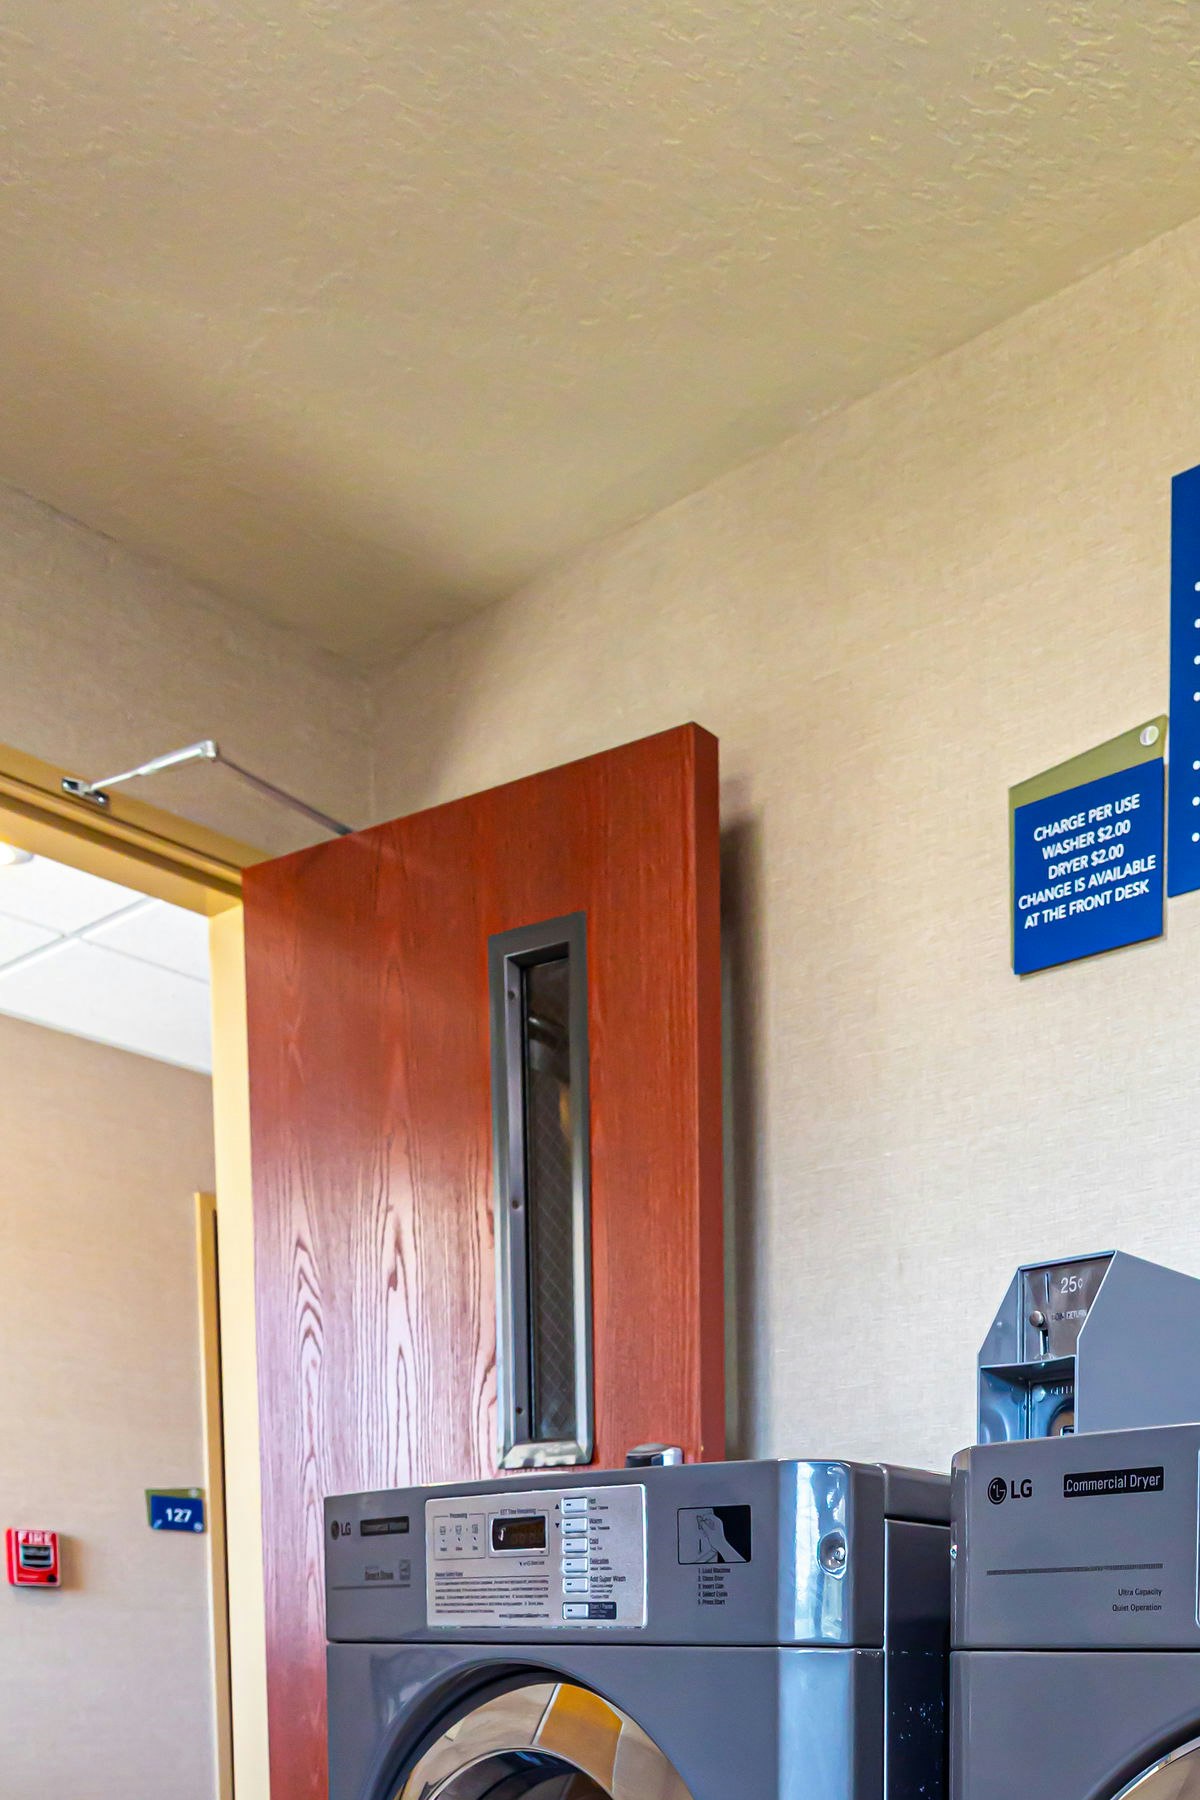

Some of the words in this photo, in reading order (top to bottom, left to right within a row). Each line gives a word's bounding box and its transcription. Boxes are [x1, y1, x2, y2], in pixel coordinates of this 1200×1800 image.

[1034, 812, 1085, 841] CHARGE
[1088, 804, 1112, 823] PER
[1115, 794, 1139, 814] USE
[1042, 831, 1094, 859] WASHER
[1097, 819, 1130, 842] $2.00
[1048, 855, 1088, 879] DRYER
[1091, 844, 1124, 866] $2.00
[1018, 881, 1071, 909] CHANGE
[1075, 877, 1085, 892] IS
[1088, 855, 1156, 888] AVAILABLE
[1025, 912, 1040, 928] AT
[1042, 904, 1066, 923] THE
[1069, 890, 1112, 915] FRONT
[1115, 879, 1149, 901] DESK
[1066, 1476, 1127, 1492] Commercial
[1130, 1474, 1161, 1489] Dryer
[166, 1508, 192, 1523] 127
[1130, 1603, 1162, 1612] Operation
